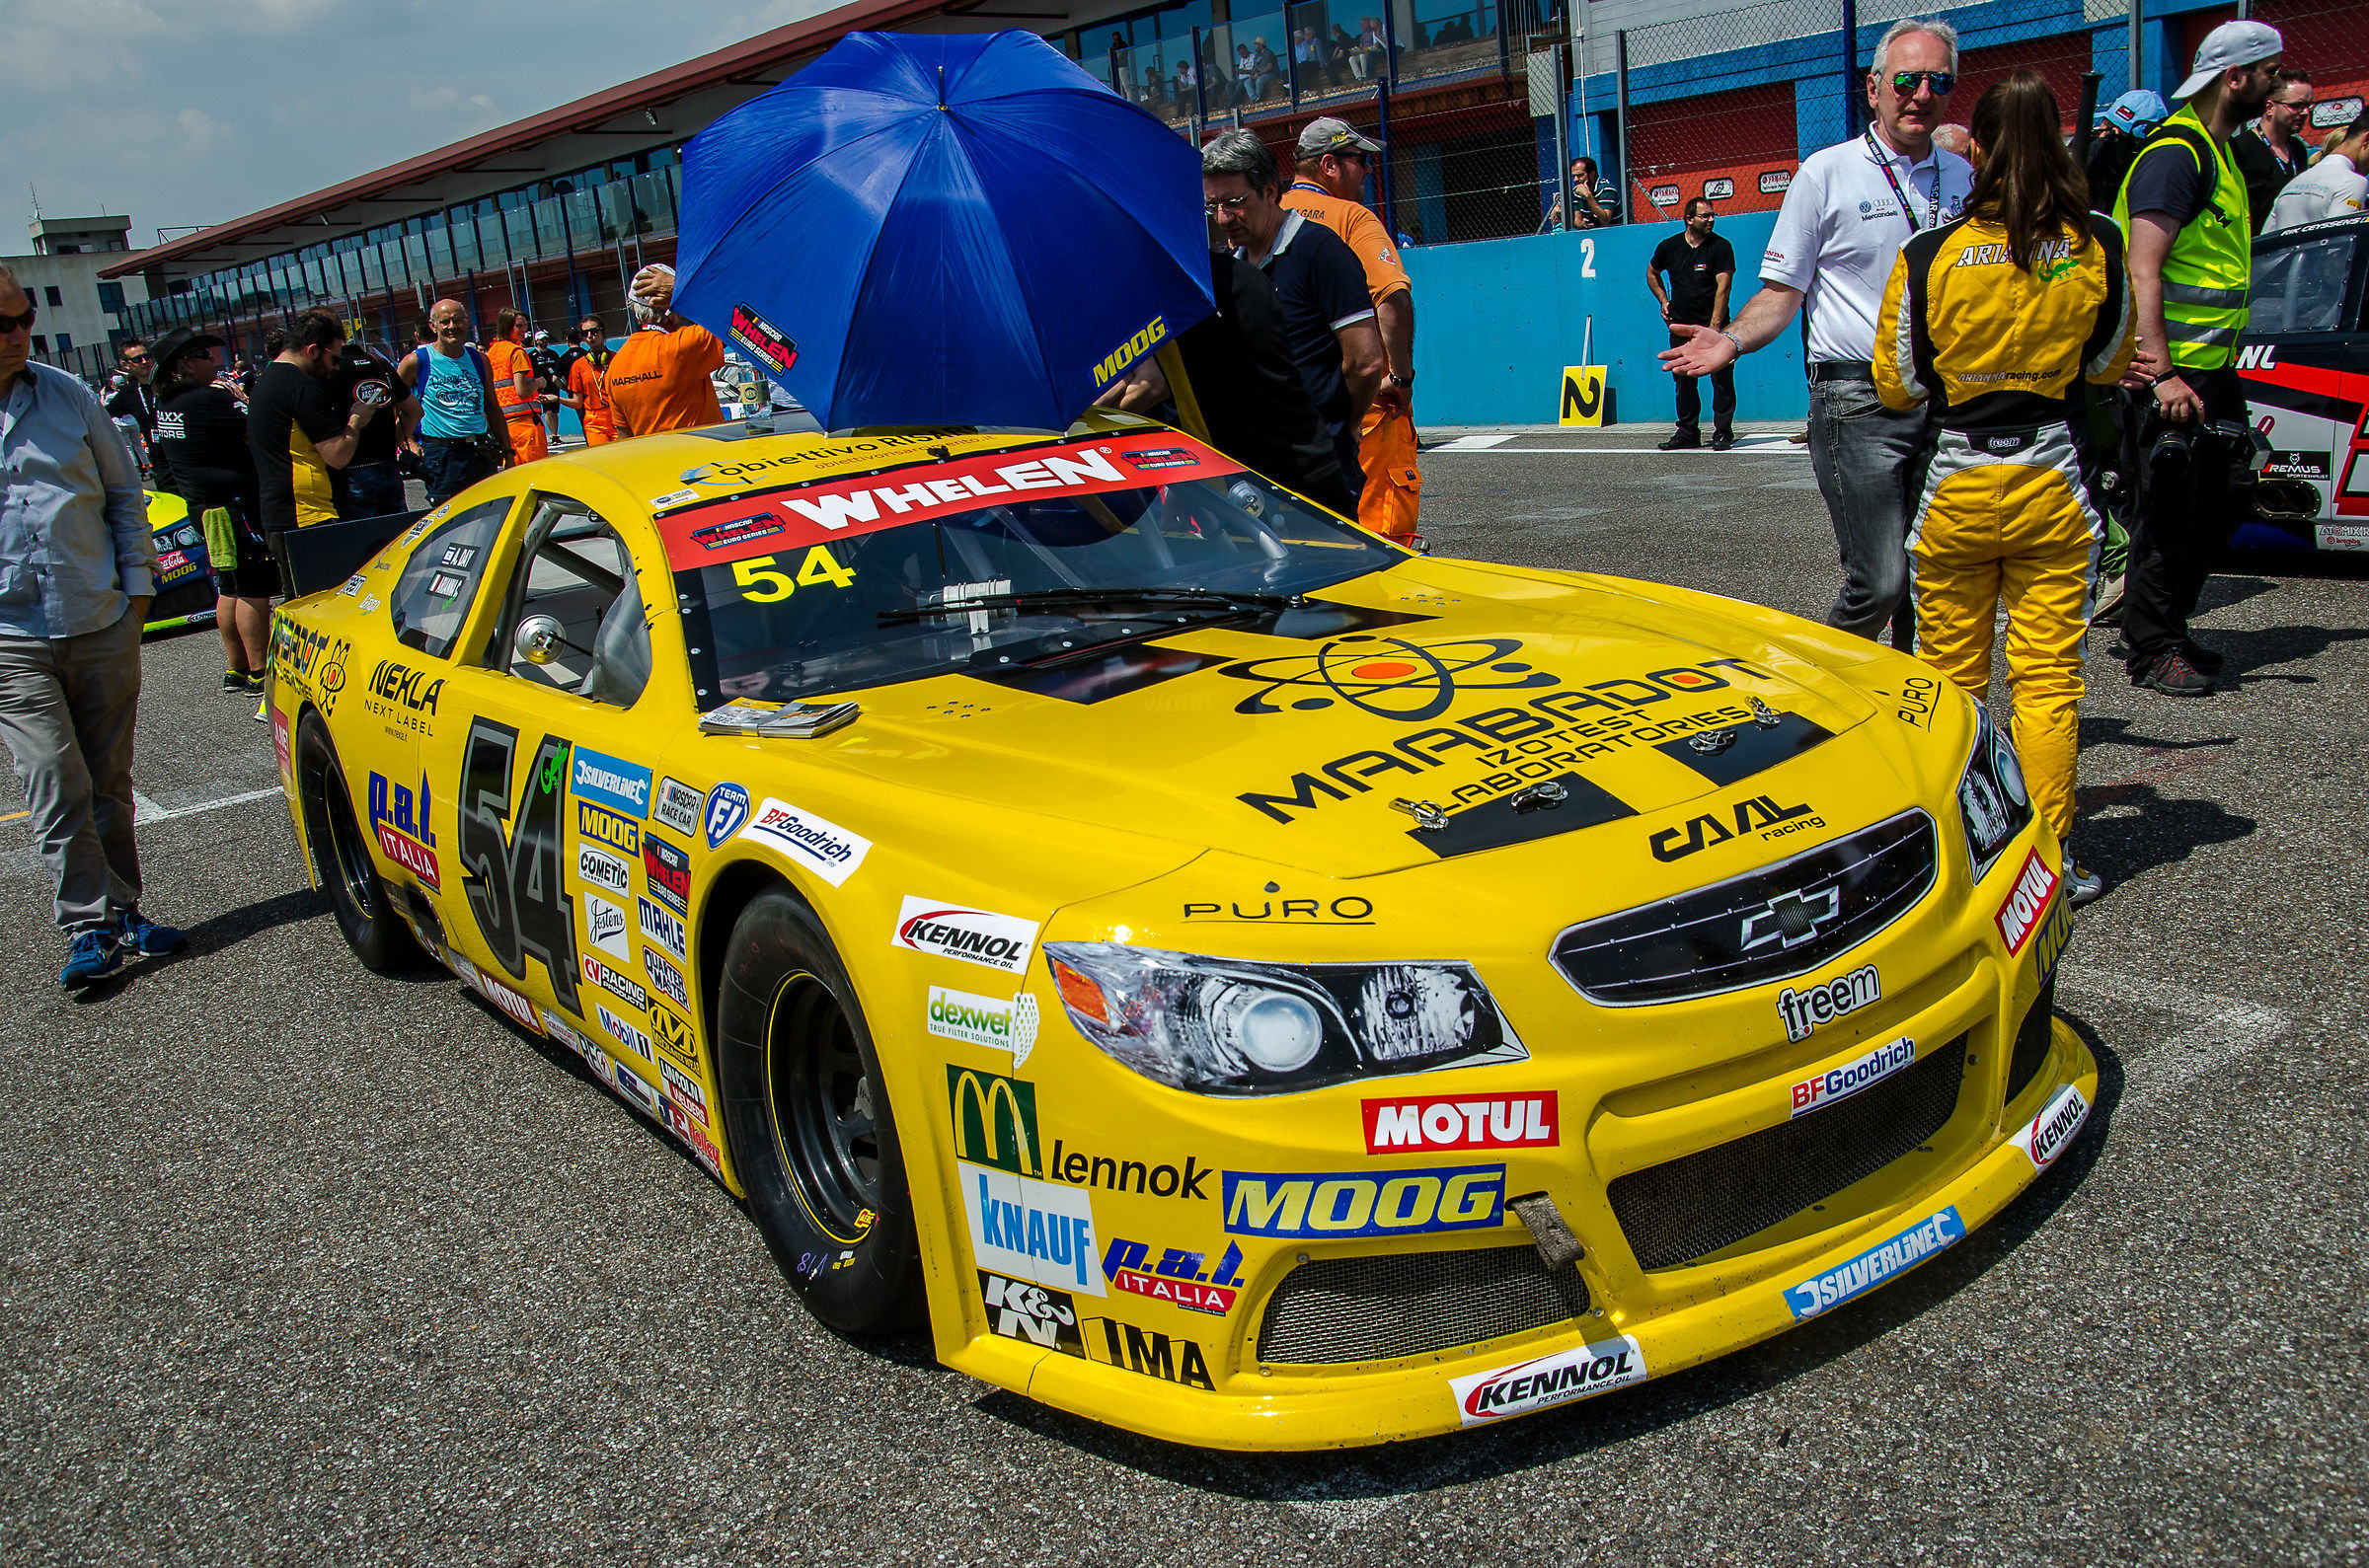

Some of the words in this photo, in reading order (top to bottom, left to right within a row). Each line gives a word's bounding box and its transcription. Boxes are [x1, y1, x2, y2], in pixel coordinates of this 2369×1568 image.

[1580, 238, 1596, 278] 2
[1955, 238, 2070, 267] ARIANA
[731, 306, 798, 369] WHELEN
[740, 336, 756, 351] EURO
[754, 346, 775, 365] SERIES
[758, 321, 783, 342] NASCAR
[1093, 315, 1168, 388] MOOG
[1563, 375, 1601, 419] 2
[721, 442, 878, 478] obiettivo
[2268, 465, 2321, 474] REMUS
[781, 448, 1127, 531] WHELEN
[691, 515, 786, 545] WHELEN
[723, 536, 742, 545] EURO
[742, 529, 768, 540] SERIES
[725, 518, 753, 531] NASCAR
[162, 562, 197, 584] MOOG
[731, 545, 857, 604] 54
[190, 611, 217, 622] KENNO
[368, 660, 446, 716] NEKLA
[1897, 677, 1934, 728] PURO
[364, 699, 393, 719] NEXT
[396, 711, 433, 737] LABEL
[1476, 707, 1658, 769] IZOTEST
[1235, 658, 1777, 825] MAABADOT
[1440, 706, 1753, 811] LABORATORIES
[661, 803, 679, 822] RACE
[678, 811, 692, 827] CAR
[673, 786, 697, 812] NASCAR
[719, 786, 746, 804] TEAM
[581, 805, 637, 852] MOOG
[708, 798, 742, 839] FJ
[760, 808, 852, 862] BFGoodrich
[1761, 814, 1828, 842] racing
[382, 830, 437, 882] ITALIA
[458, 714, 586, 1021] 54
[580, 852, 628, 889] COMETIC
[643, 846, 691, 900] WHELEN
[590, 898, 624, 944] Jostens
[1184, 896, 1373, 919] PURO
[2001, 856, 2054, 950] MOTUL
[639, 896, 686, 956] MAHLE
[906, 920, 1022, 962] KENNOL
[645, 947, 686, 992] QUARTER
[943, 947, 1001, 967] PERFORMANCE
[1000, 960, 1014, 970] OIL
[481, 973, 540, 1029] MOTUL
[602, 965, 646, 1002] RACING
[603, 980, 646, 1010] PRODUCTS
[1782, 968, 1878, 1031] freem
[599, 1007, 638, 1053] Mobil
[930, 992, 1013, 1036] dexwet
[930, 1023, 946, 1035] TRUE
[948, 1027, 970, 1040] FILTER
[970, 1032, 1011, 1049] SOLUTIONS
[659, 1060, 700, 1103] LINCOLN
[1793, 1037, 1914, 1110] BFGoodrich
[673, 1089, 706, 1124] WELDERS
[1373, 1099, 1551, 1147] MOTUL
[2034, 1093, 2085, 1160] KENNOL
[1227, 1171, 1503, 1231] MOOG
[978, 1173, 1091, 1286] KNAUF
[1123, 1273, 1226, 1309] ITALIA
[1479, 1351, 1633, 1411] KENNOL
[1537, 1380, 1614, 1404] PERFORMANCE
[1615, 1376, 1632, 1385] OIL
